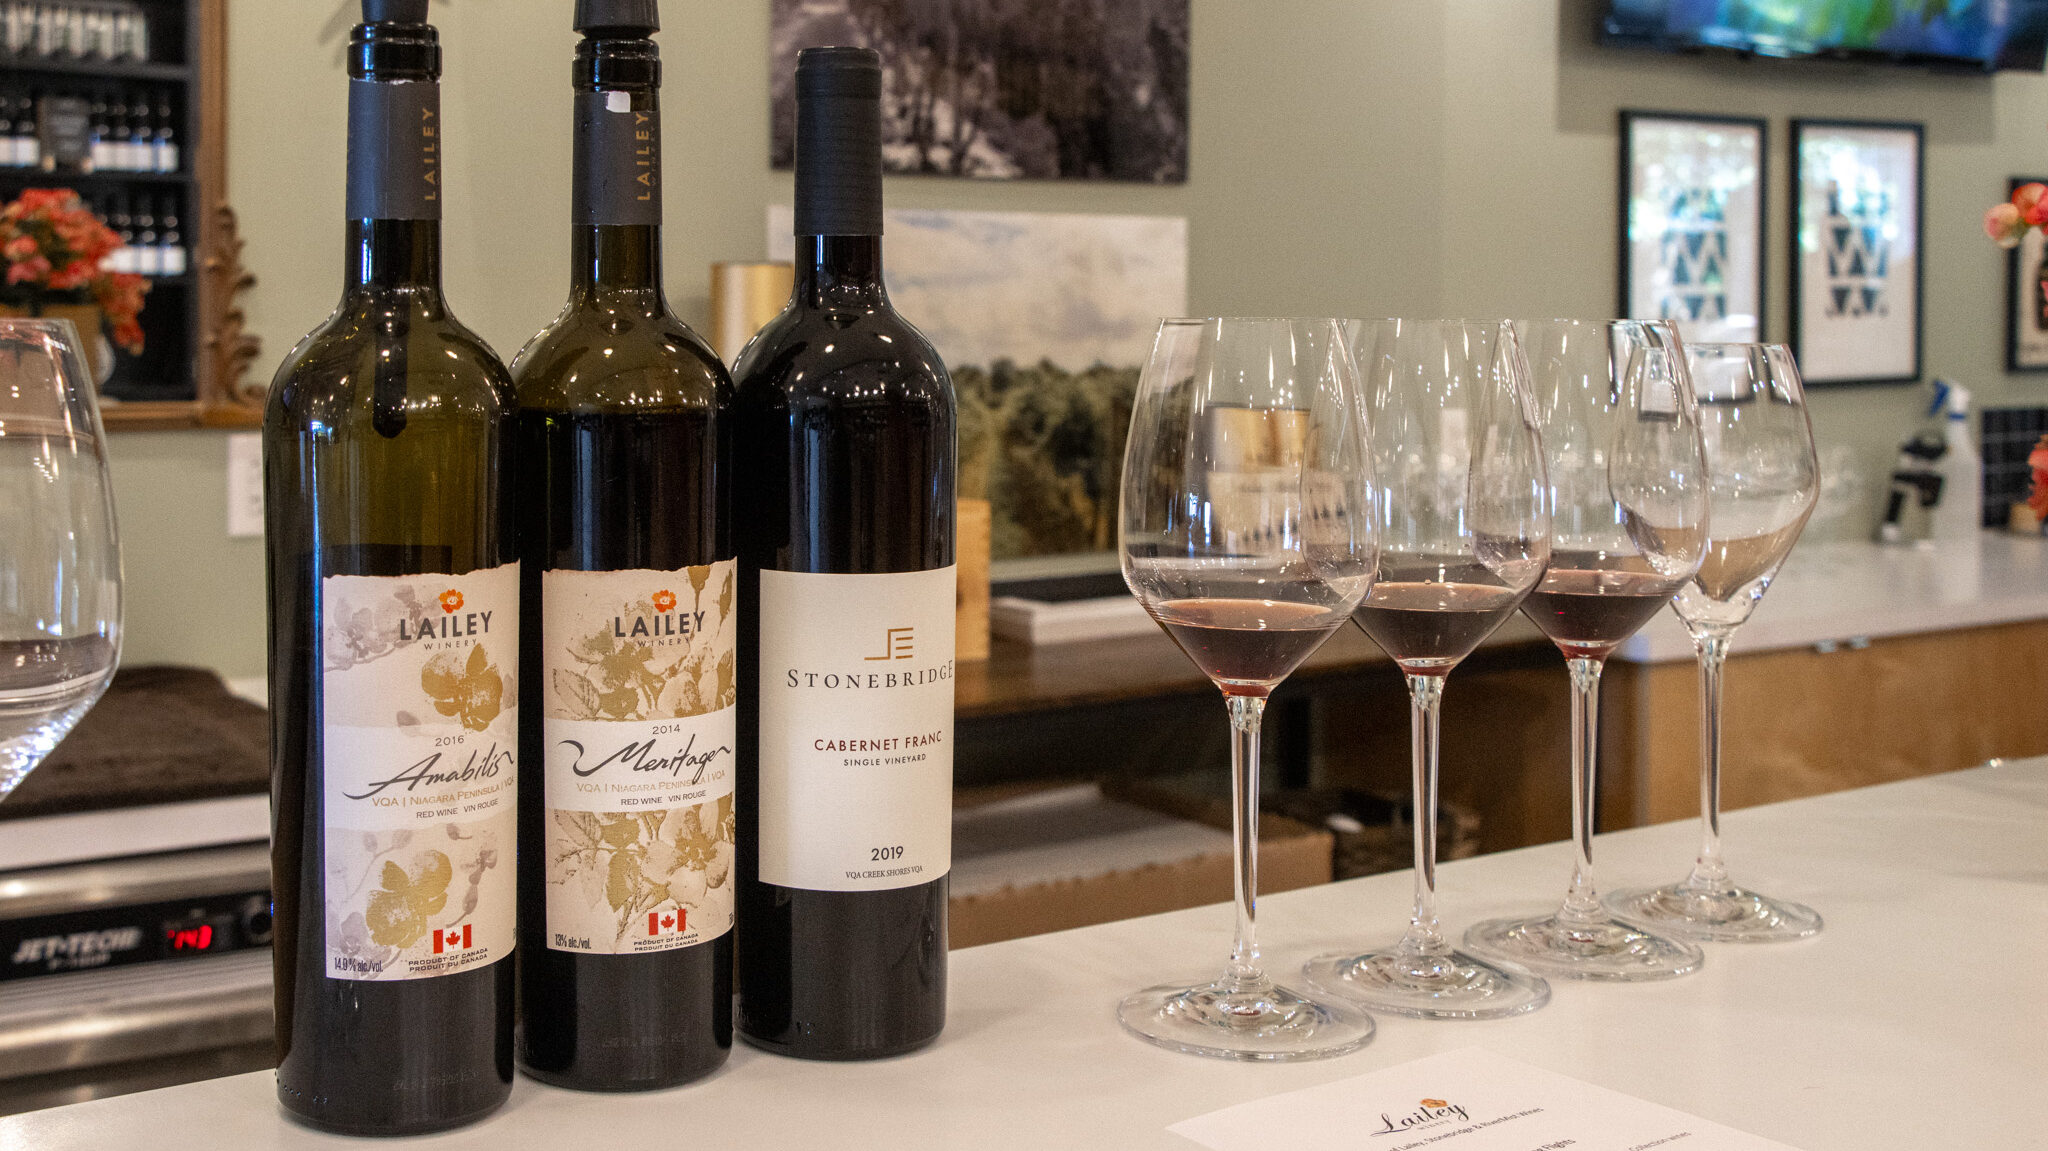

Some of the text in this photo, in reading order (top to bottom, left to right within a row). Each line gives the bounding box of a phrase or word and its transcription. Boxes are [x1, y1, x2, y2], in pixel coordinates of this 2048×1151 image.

[422, 107, 437, 201] LAILEY
[635, 111, 651, 201] LAILEY
[400, 610, 493, 641] LAILEY
[614, 610, 706, 638] LAILEY
[424, 638, 478, 650] WINERY
[637, 637, 690, 648] WINERY
[787, 660, 953, 689] STONEBRIDGE
[652, 724, 681, 735] 2014
[435, 735, 465, 747] 2016
[814, 730, 942, 752] CABERNET FRANC
[843, 753, 927, 767] SINGLE VINEYARD
[342, 742, 514, 800] Amabilis
[577, 783, 601, 793] VQA
[611, 783, 656, 793] NIAGARA
[711, 769, 726, 782] VQA
[372, 797, 399, 807] VQA
[410, 793, 456, 806] NIAGARA
[457, 784, 500, 801] PENINSULA
[620, 790, 707, 806] RED WINE VIN ROUGE
[416, 798, 499, 819] RED WINE VIN ROUGE
[871, 846, 904, 861] 2019
[845, 865, 923, 880] VQA CREEK SHORES VQA
[568, 936, 592, 950] alc./vol.
[633, 938, 665, 946] PRODUCT
[676, 933, 699, 941] CANADA
[634, 944, 664, 952] PRODUIT
[676, 939, 699, 947] CANADA
[357, 959, 384, 973] alc./vol.
[408, 947, 489, 966] PRODUCT OF CANADA
[409, 962, 446, 973] PRODUIT
[461, 953, 488, 965] CANADA
[1369, 1102, 1470, 1137] Lailey
